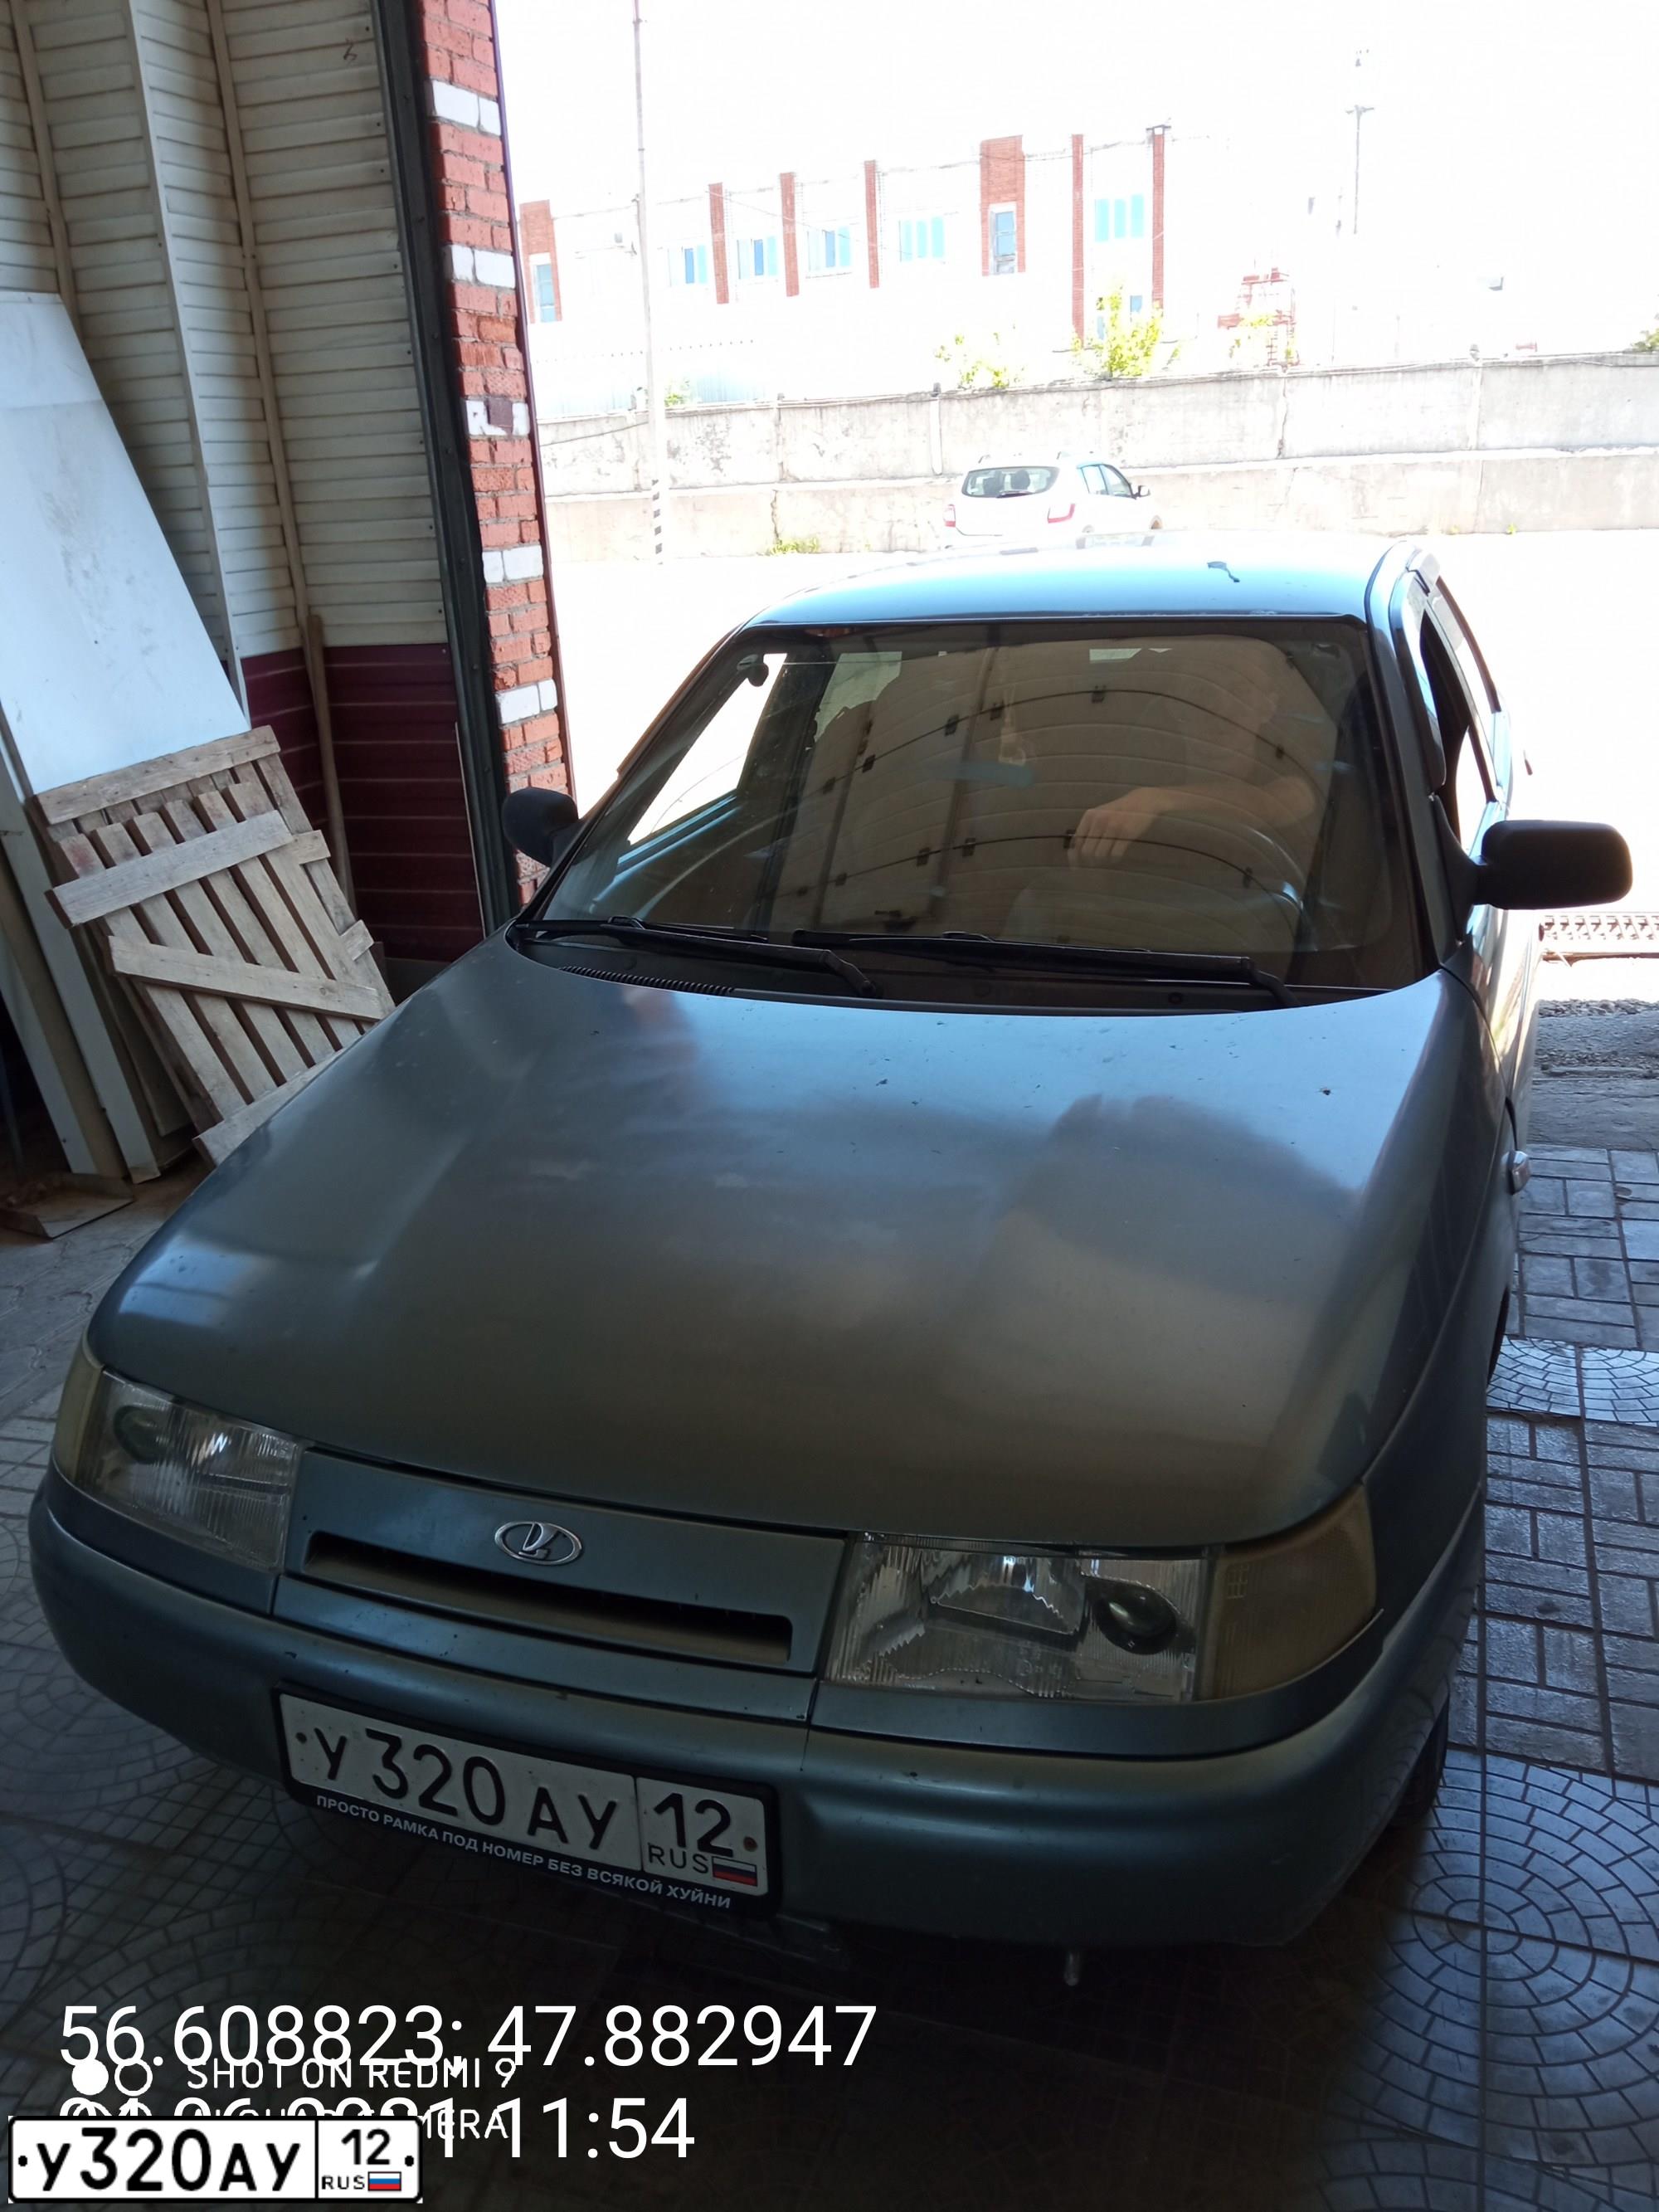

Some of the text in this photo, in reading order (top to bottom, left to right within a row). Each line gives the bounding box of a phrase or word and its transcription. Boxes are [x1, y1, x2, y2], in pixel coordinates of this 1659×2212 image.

[317, 1795, 731, 1909] ПРОСТО РАМКА ПОД НОМЕР БЕЗ ВСЯКОЙ ХУЙНИ
[654, 1792, 733, 1857] 12
[647, 1844, 708, 1873] RUS
